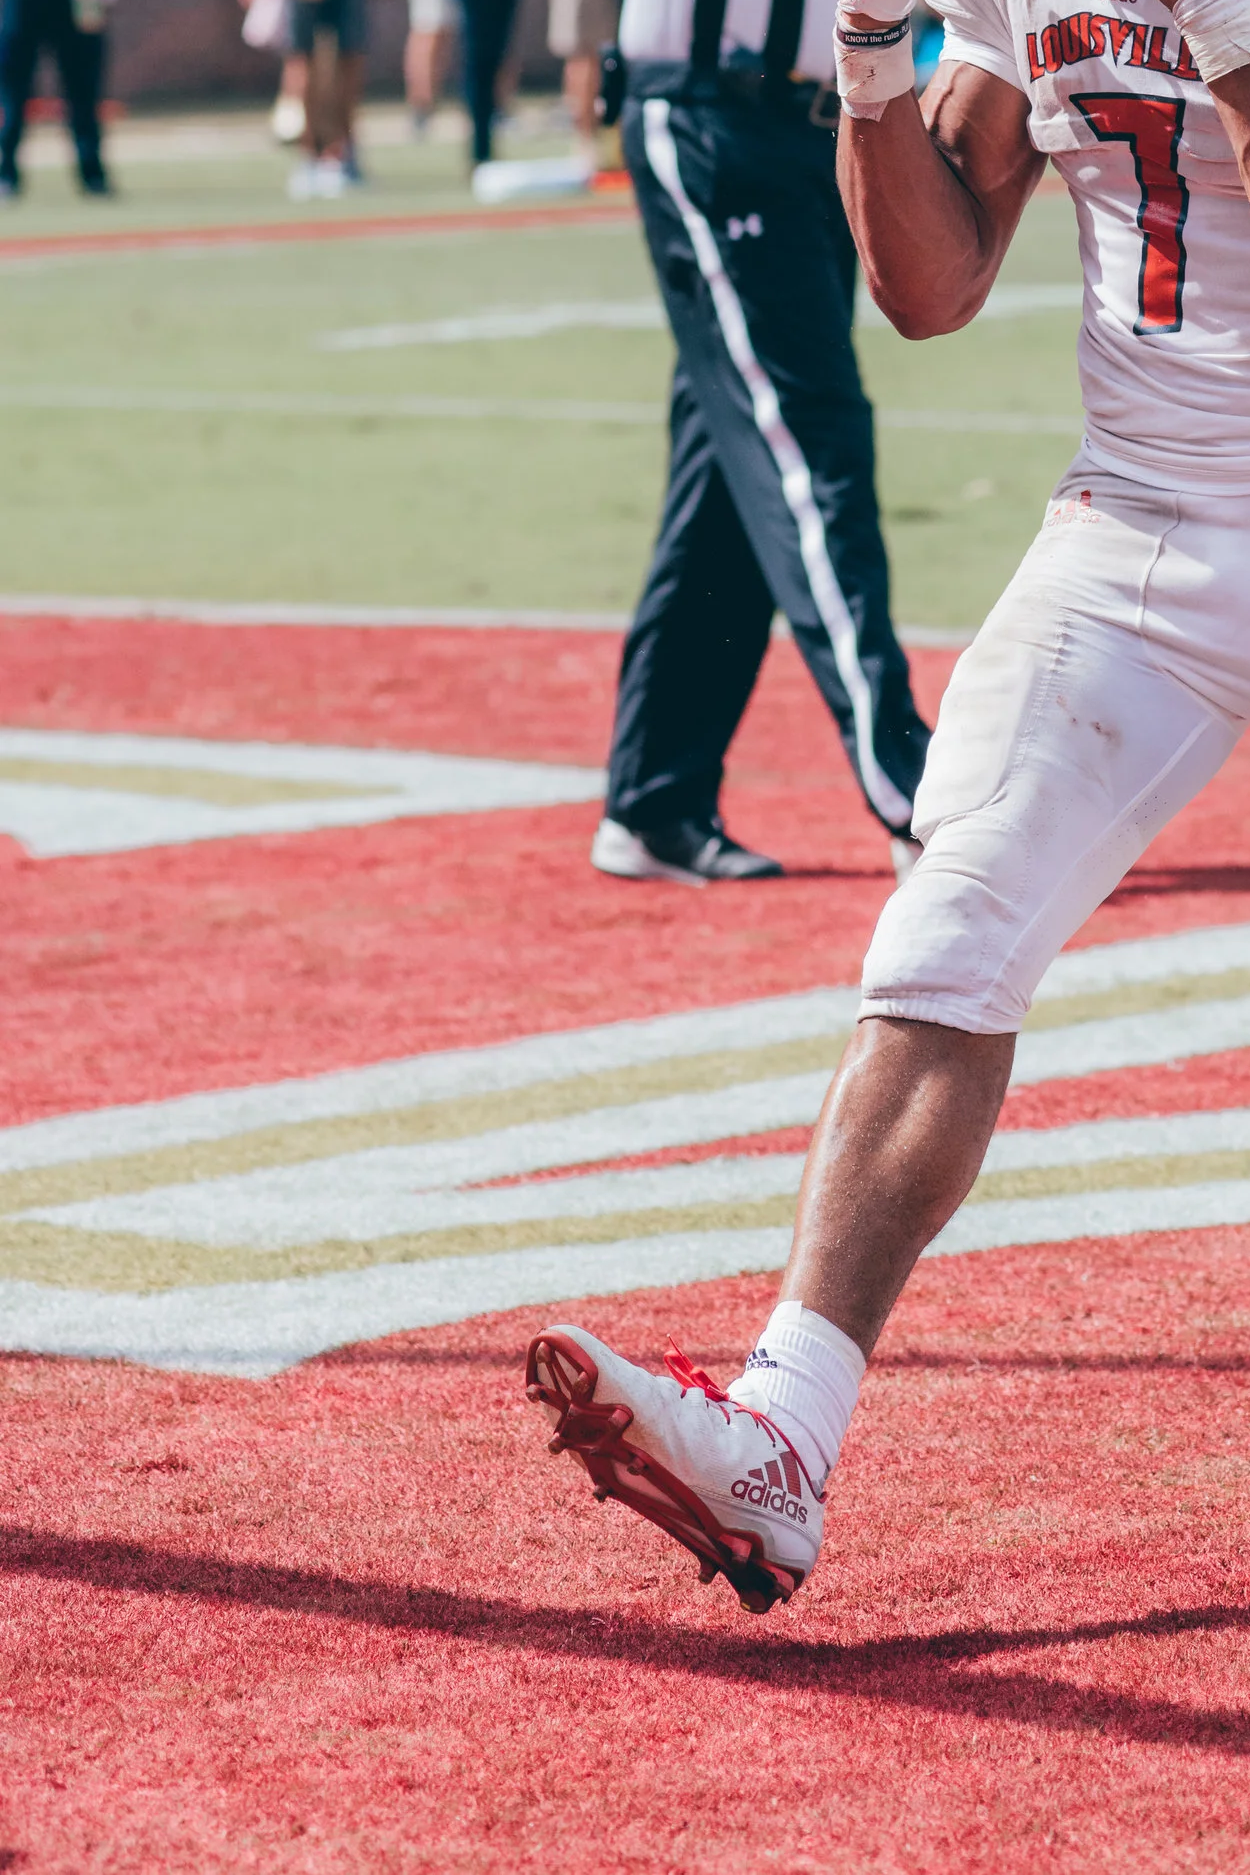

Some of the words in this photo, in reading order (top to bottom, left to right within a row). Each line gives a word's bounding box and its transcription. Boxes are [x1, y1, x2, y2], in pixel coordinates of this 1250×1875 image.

[845, 34, 868, 43] KNOW
[869, 35, 882, 43] the
[883, 30, 900, 41] rules
[1026, 11, 1204, 83] LOUISVILL
[1069, 92, 1189, 335] 7
[730, 1479, 808, 1525] adidas
